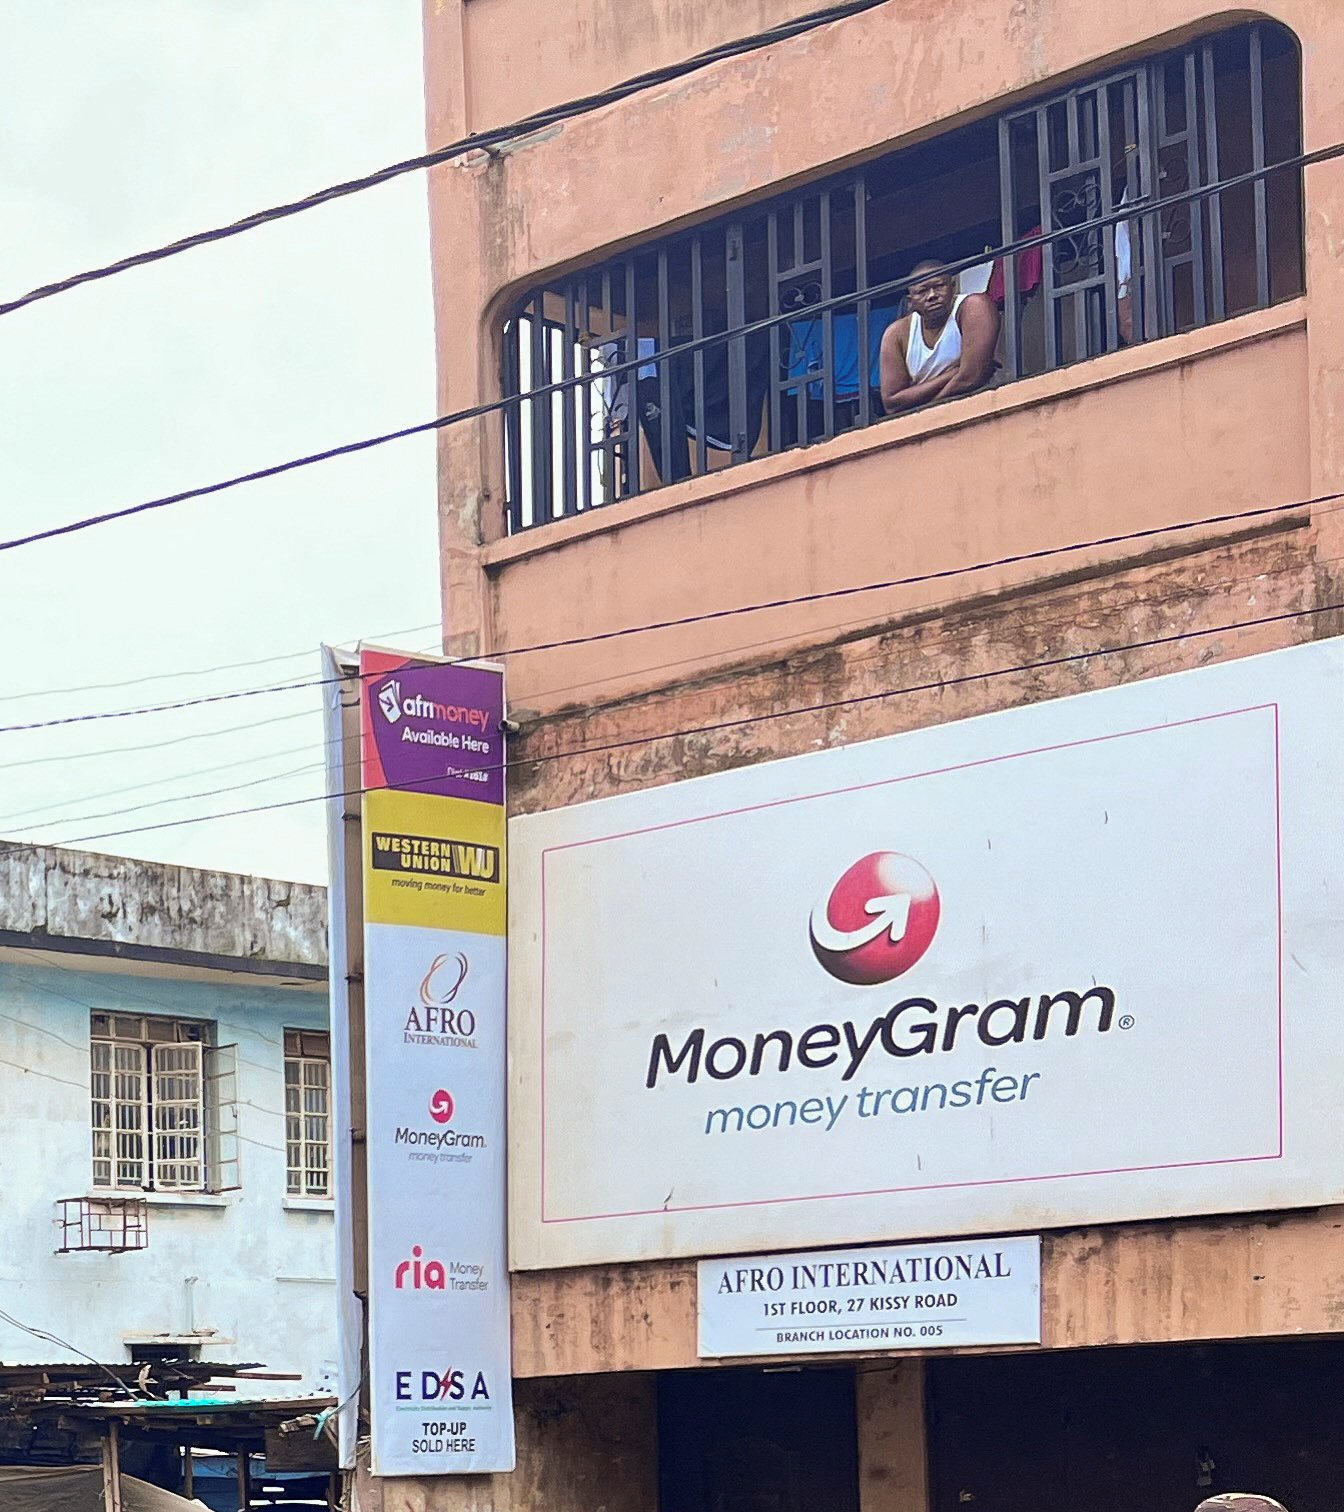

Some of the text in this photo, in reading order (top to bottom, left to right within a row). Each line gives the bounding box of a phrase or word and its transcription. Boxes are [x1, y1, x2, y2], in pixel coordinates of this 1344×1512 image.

[401, 726, 490, 754] Available Here
[375, 836, 495, 879] WESTERN WU
[400, 854, 451, 873] UNION
[391, 878, 486, 896] moving money for better
[404, 1006, 476, 1037] AFRO
[403, 1032, 478, 1049] INTERNATIONAL
[646, 985, 1117, 1088] MoneyGram
[703, 1066, 1041, 1135] money transfer
[395, 1128, 485, 1150] MoneyGram
[408, 1151, 473, 1165] money transfer
[395, 1245, 484, 1290] ria Money
[717, 1251, 1012, 1295] AFRO INTERNATIONAL
[450, 1278, 489, 1291] Transfer
[764, 1293, 958, 1316] 1ST FLOOR, 27 KISSY ROAD
[776, 1324, 943, 1343] BRANCH LOCATION NO. 005
[395, 1371, 490, 1400] EDSA
[422, 1422, 467, 1436] TOP-UP
[412, 1438, 476, 1453] SOLD HERE
